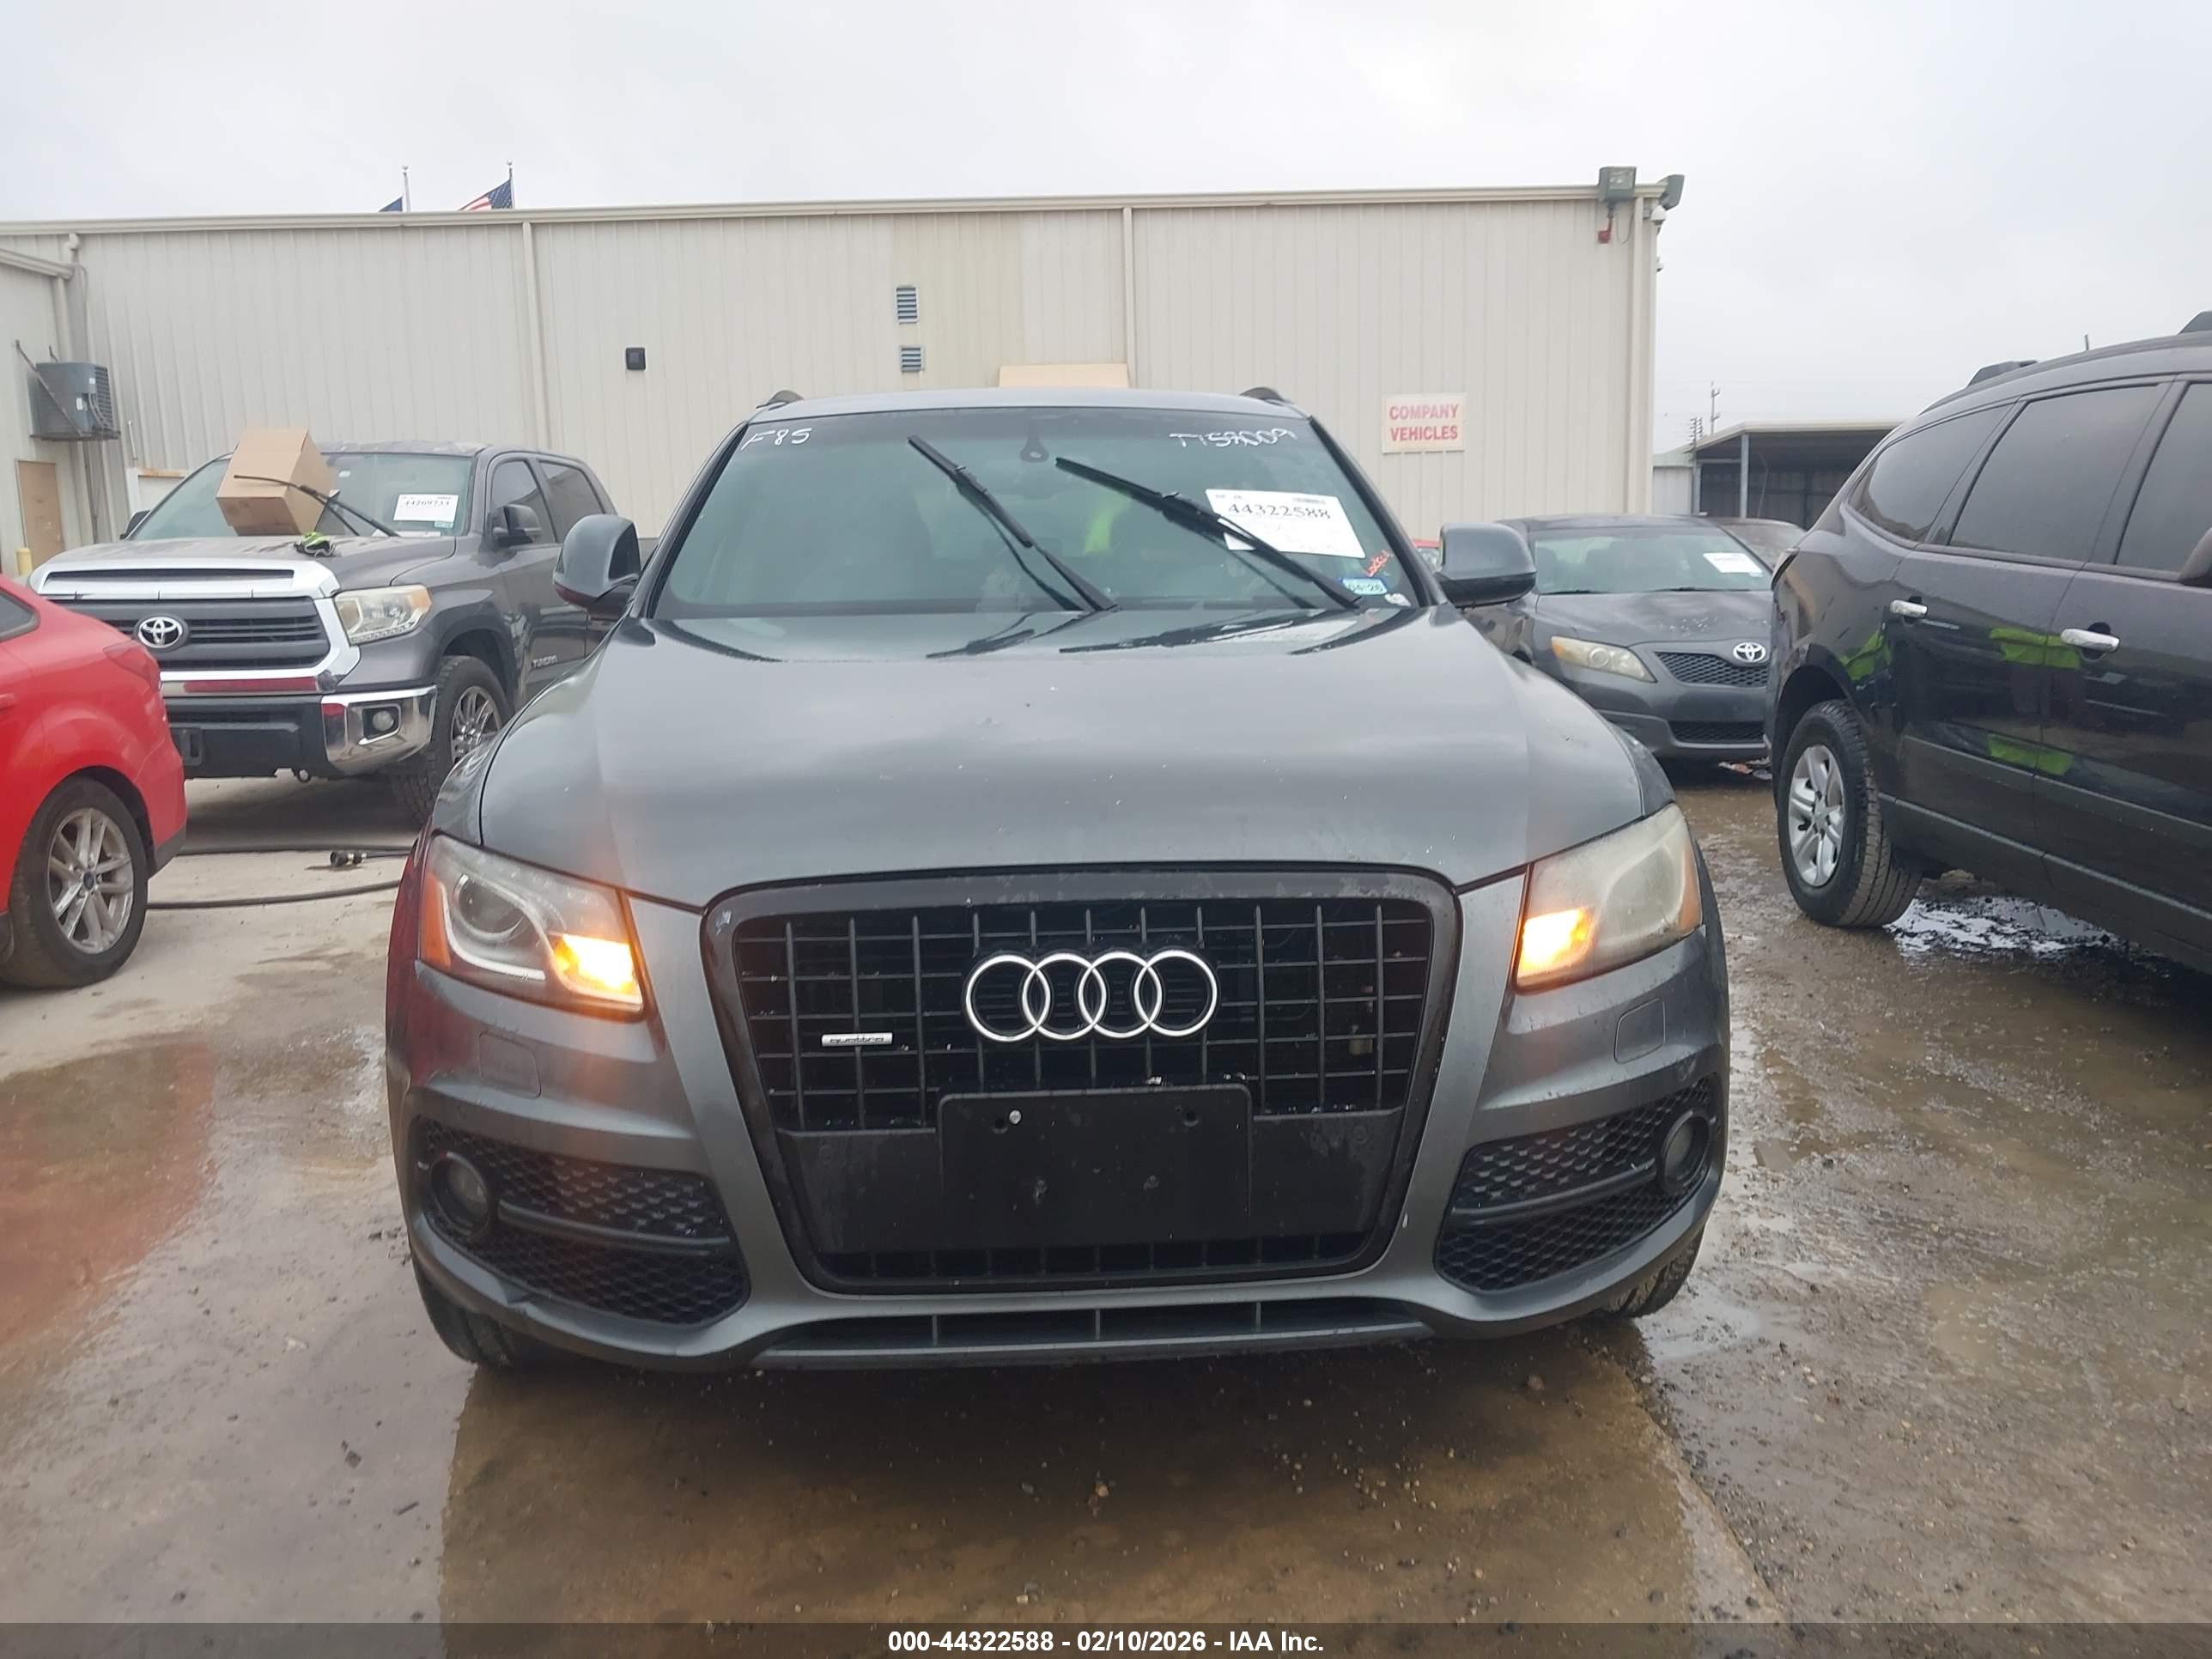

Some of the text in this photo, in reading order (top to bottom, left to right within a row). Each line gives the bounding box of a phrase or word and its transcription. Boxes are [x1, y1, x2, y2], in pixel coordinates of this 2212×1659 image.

[1389, 404, 1458, 420] COMPANY
[1390, 425, 1458, 441] VEHICLES
[1229, 503, 1331, 520] 44322588
